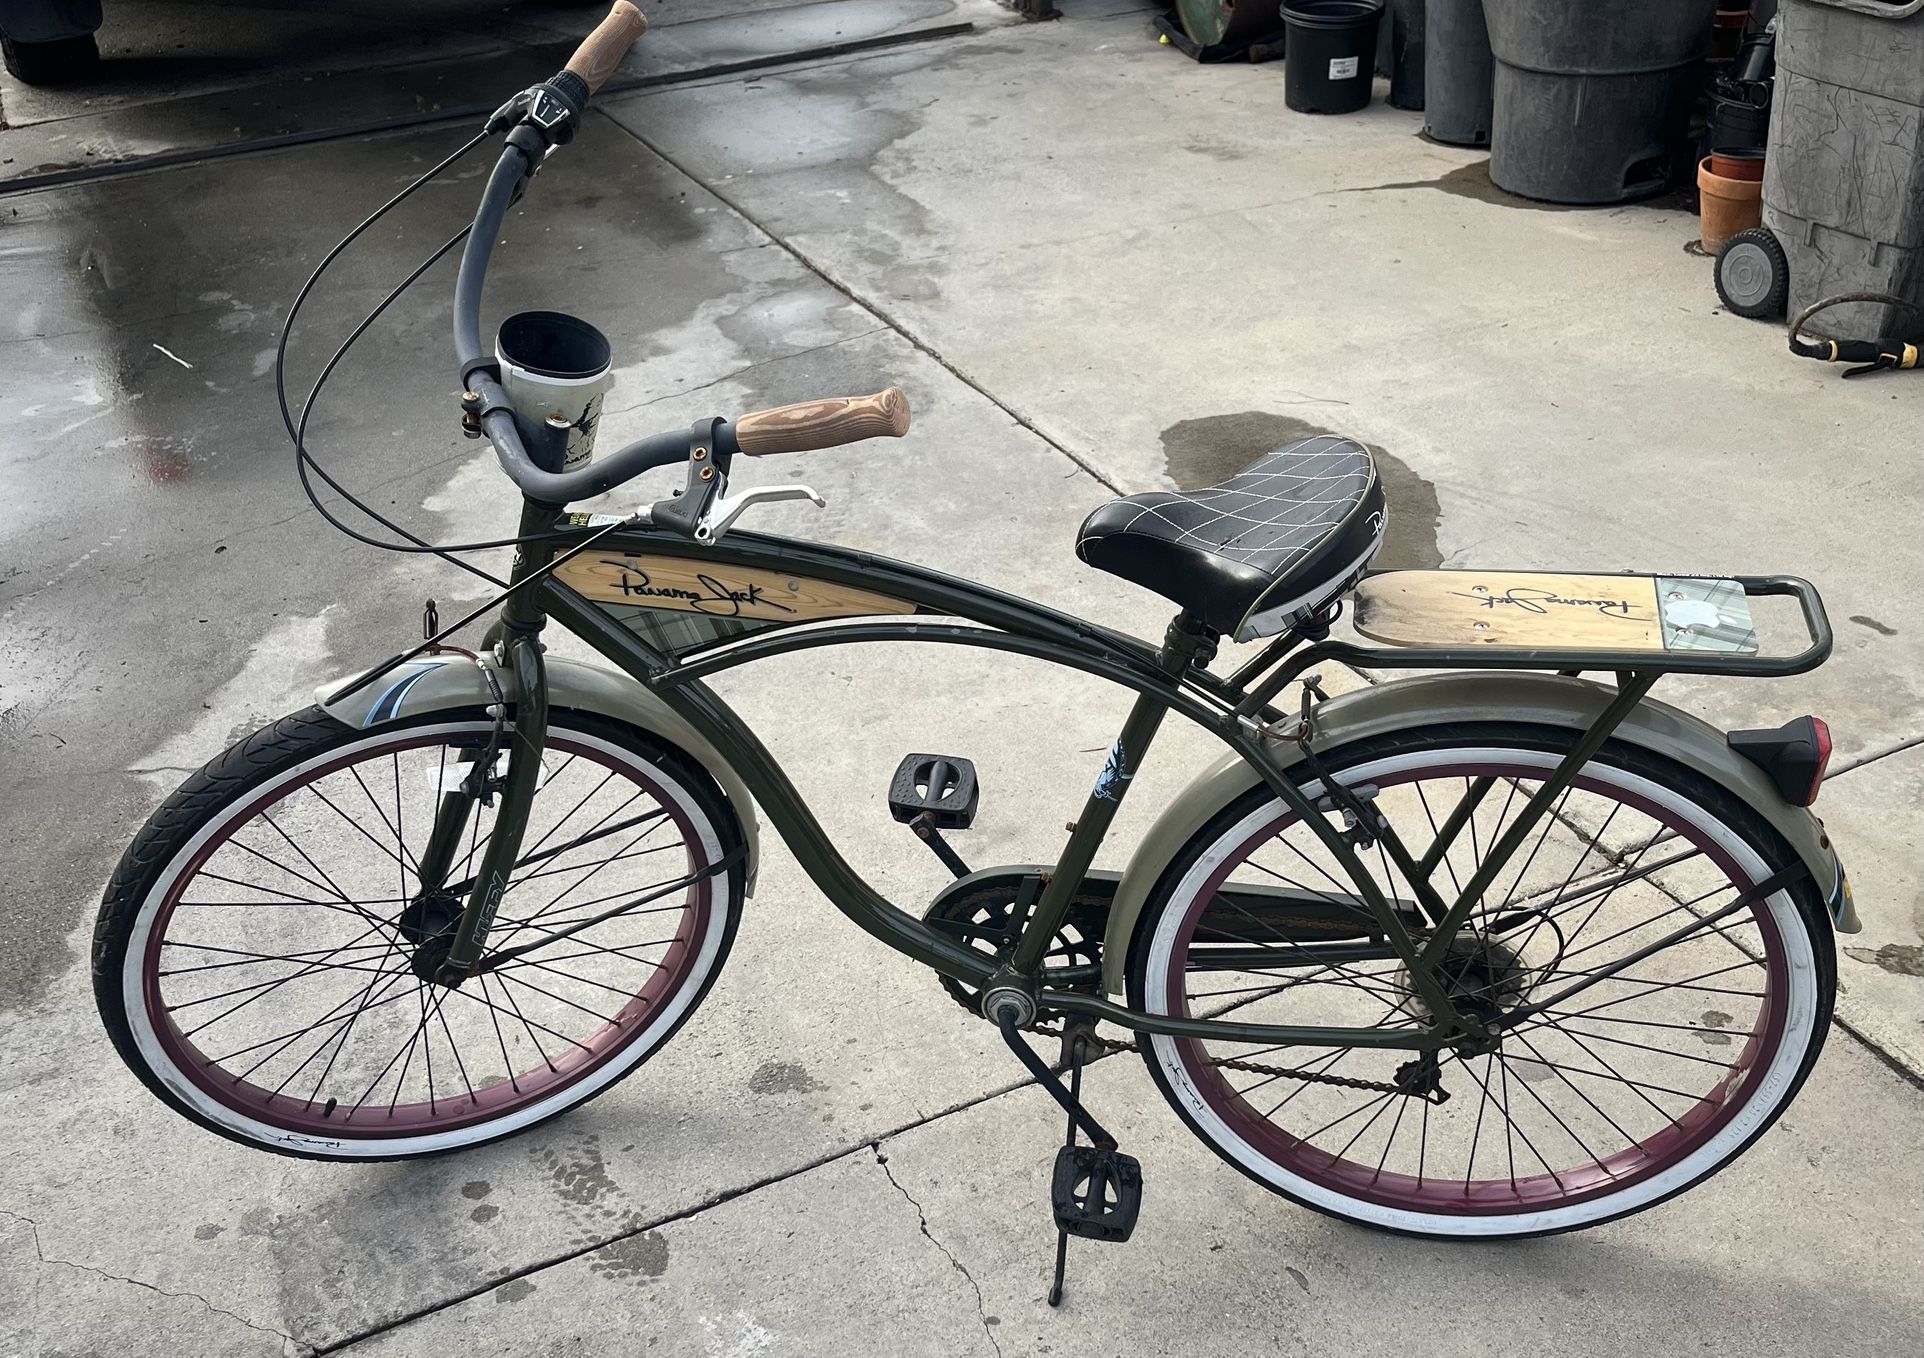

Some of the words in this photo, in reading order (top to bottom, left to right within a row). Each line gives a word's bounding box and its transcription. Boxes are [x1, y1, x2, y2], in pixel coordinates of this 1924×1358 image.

[599, 560, 701, 601] Panama
[689, 574, 797, 617] Jack
[1446, 587, 1558, 614] Jack
[1543, 594, 1652, 622] Panama
[471, 869, 506, 947] HUFFY
